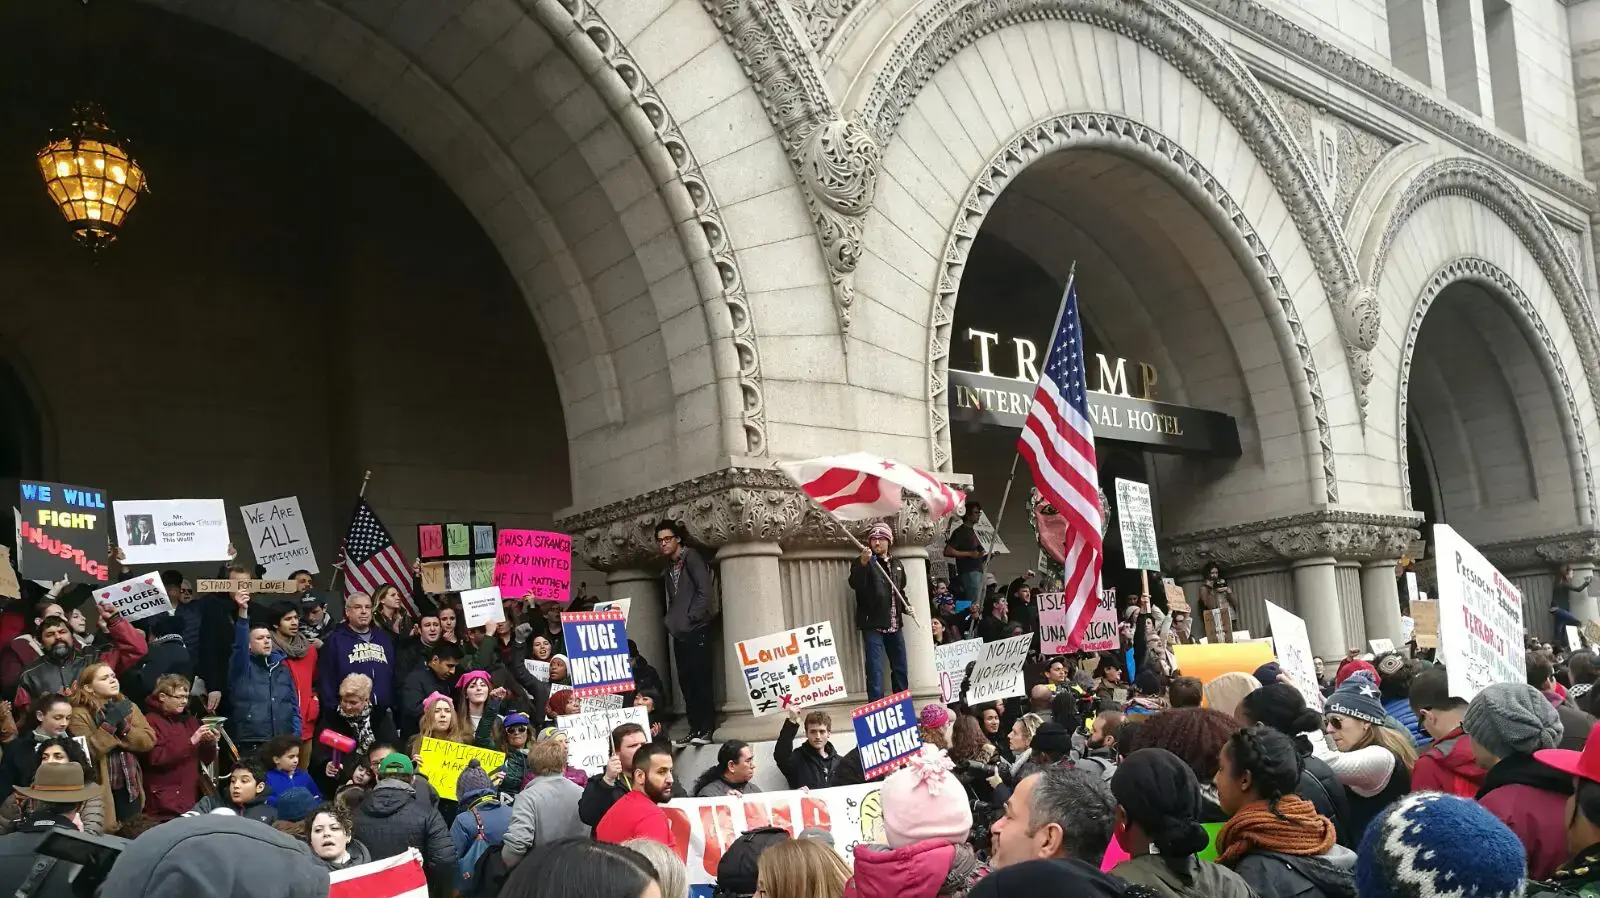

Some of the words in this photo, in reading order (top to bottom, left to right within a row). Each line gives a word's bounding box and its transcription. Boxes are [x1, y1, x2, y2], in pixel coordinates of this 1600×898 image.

[969, 328, 1158, 401] TRMP
[955, 384, 1122, 428] INTERNNAL
[1126, 408, 1184, 436] HOTEL
[22, 485, 51, 502] WE
[63, 488, 106, 509] WILL
[38, 509, 97, 530] FIGHT
[260, 523, 300, 548] ALL
[505, 534, 524, 547] WAS
[525, 534, 533, 547] A
[21, 521, 109, 581] INJUSTICE
[260, 547, 309, 565] IMMIGRANTS
[513, 553, 529, 566] YOU
[531, 555, 570, 571] INVITED
[200, 580, 232, 591] STAND
[237, 581, 253, 590] FOR
[259, 581, 285, 591] LOVE!
[510, 571, 523, 588] IN
[111, 587, 160, 608] EFUGEES
[119, 597, 166, 617] ELCOME
[1039, 589, 1117, 612] ISLABIA
[576, 623, 618, 652] YUGE
[806, 625, 824, 636] OF
[1040, 620, 1117, 643] UNAICAN
[1462, 604, 1505, 657] TERRORIST
[738, 632, 800, 667] Land
[986, 642, 1005, 661] NO
[570, 653, 633, 686] MISTAKE
[974, 666, 992, 684] NO
[992, 660, 1023, 679] FEAR!
[750, 687, 768, 700] OF
[974, 685, 986, 700] NO
[865, 703, 906, 738] YUGE
[1330, 702, 1382, 725] denizens
[860, 725, 922, 769] MISTAKE
[441, 760, 466, 772] MAK
